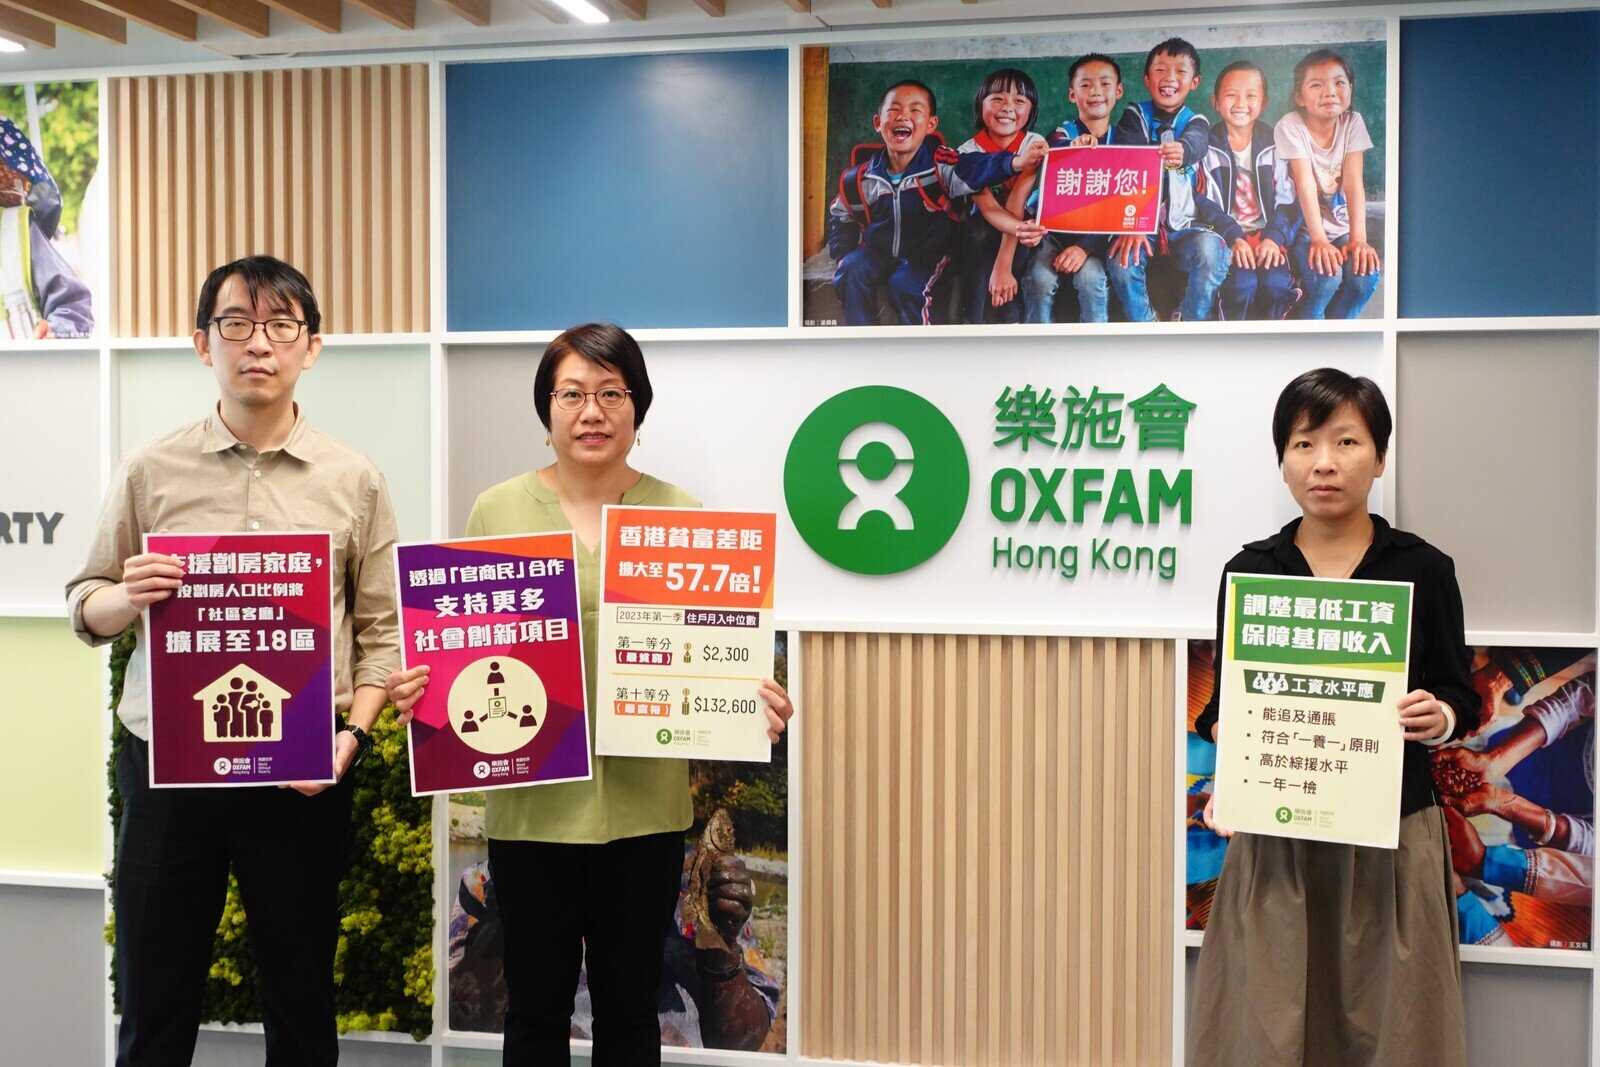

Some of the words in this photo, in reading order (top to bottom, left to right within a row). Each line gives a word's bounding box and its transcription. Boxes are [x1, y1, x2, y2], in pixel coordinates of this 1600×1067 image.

[1056, 168, 1148, 196] 謝謝您!
[994, 382, 1197, 452] 樂施會
[990, 467, 1193, 525] OXFAM
[620, 525, 763, 551] 香港貧富差距
[993, 537, 1079, 579] Hong
[1092, 538, 1177, 581] Kong
[409, 559, 565, 588] 透過「官商民」合作
[198, 606, 284, 621] 「社區客廳」
[434, 587, 545, 618] 支持更多
[619, 610, 683, 622] 2023年第一季
[1243, 594, 1395, 625] 調整最低工資
[165, 628, 315, 653] 擴展至18區
[414, 618, 569, 652] 社會創新項目
[617, 635, 672, 651] 第一等分
[703, 645, 749, 663] $2,300
[1241, 623, 1392, 655] 保障基層收入
[616, 687, 670, 702] 第十等分
[694, 697, 757, 715] $132,600
[1291, 677, 1375, 699] 工資水平應
[1262, 706, 1336, 726] 能追及通脹
[1261, 730, 1379, 754] 符合「一養一」原則
[1259, 753, 1348, 774] 高於綜援水平
[1258, 777, 1317, 795] 一年一檢
